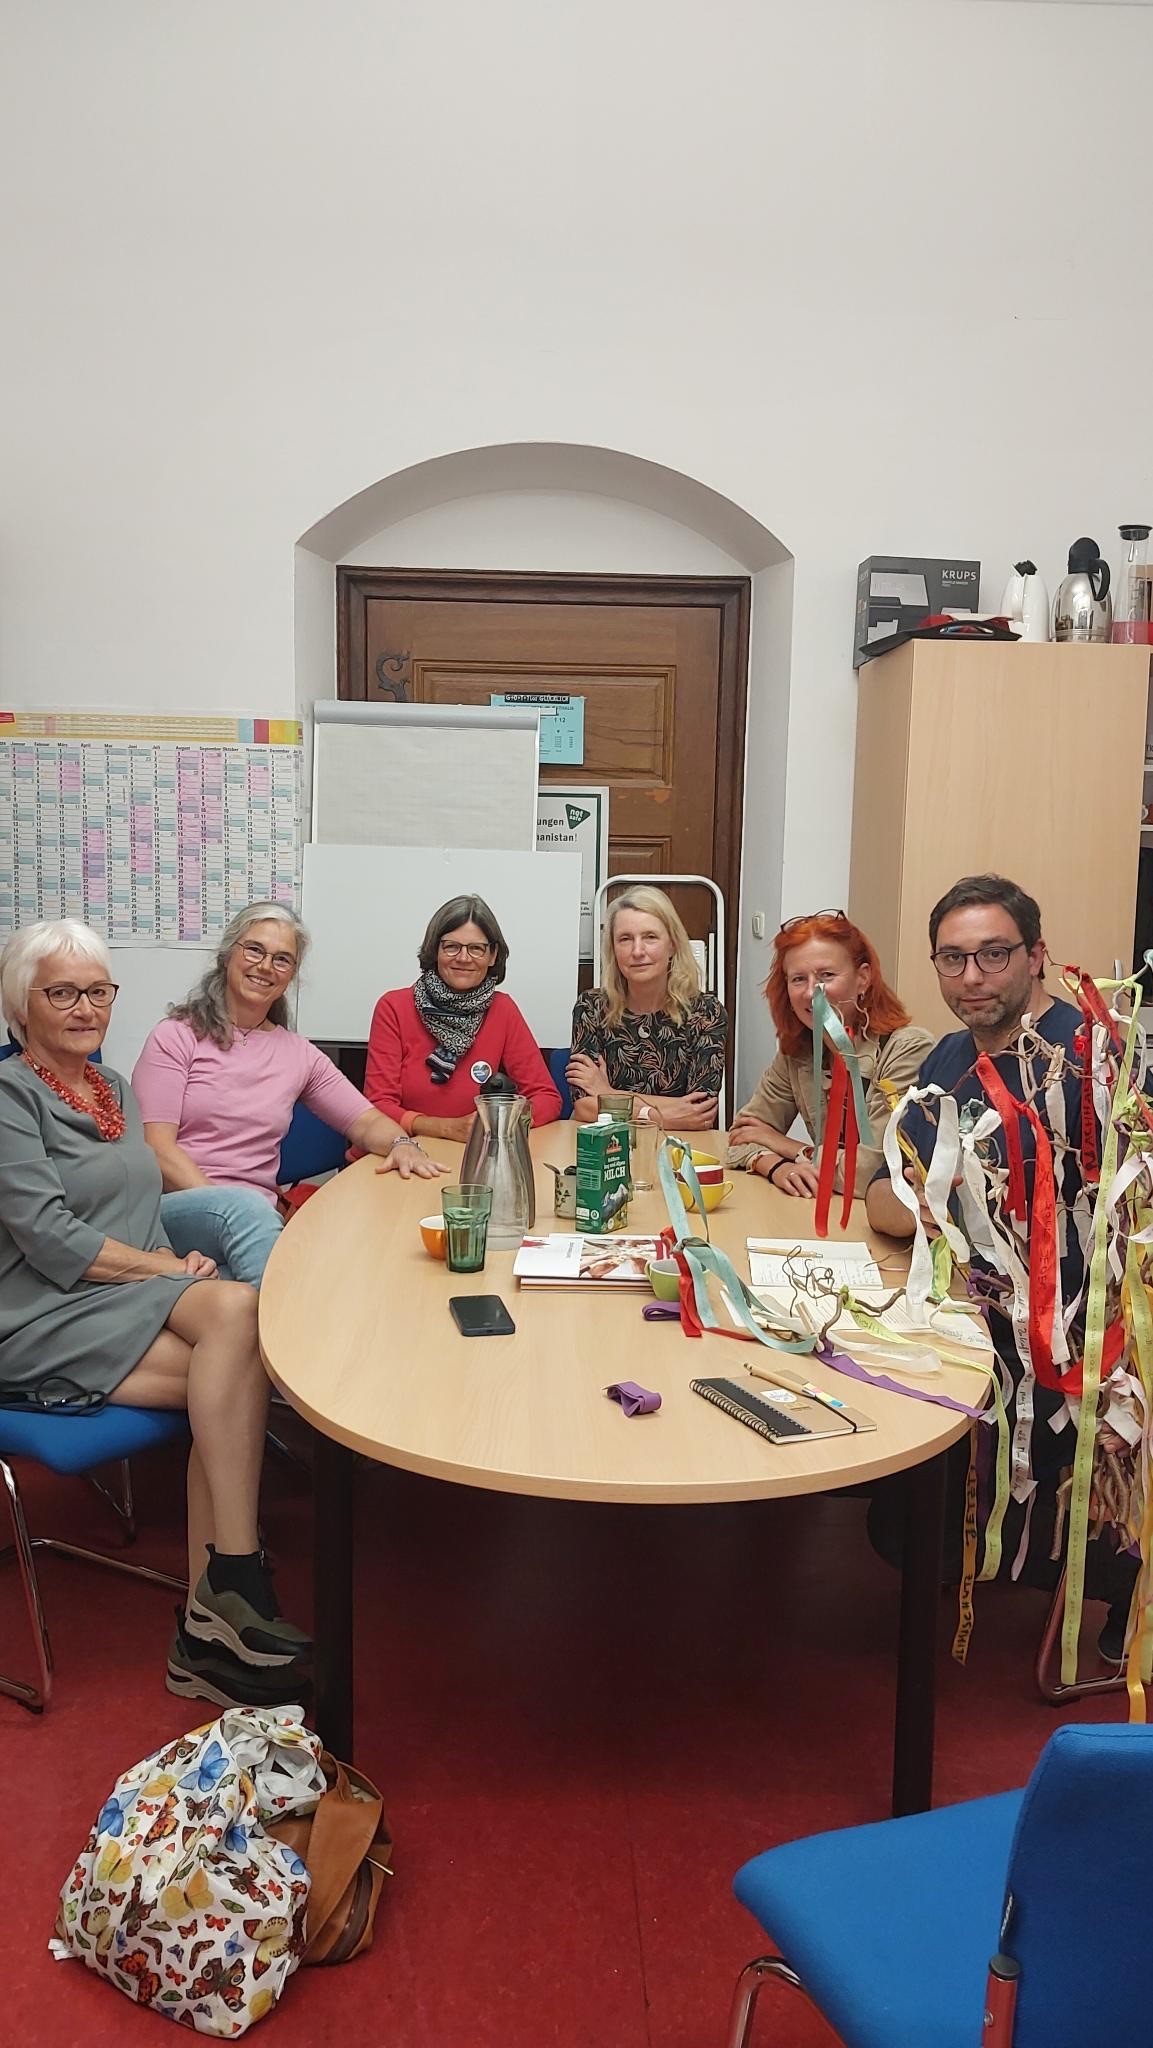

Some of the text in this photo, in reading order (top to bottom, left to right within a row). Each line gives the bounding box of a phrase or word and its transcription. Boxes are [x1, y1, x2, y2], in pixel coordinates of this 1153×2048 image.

[941, 569, 977, 581] KRUPS
[570, 809, 583, 817] not
[604, 1166, 626, 1182] MILCH
